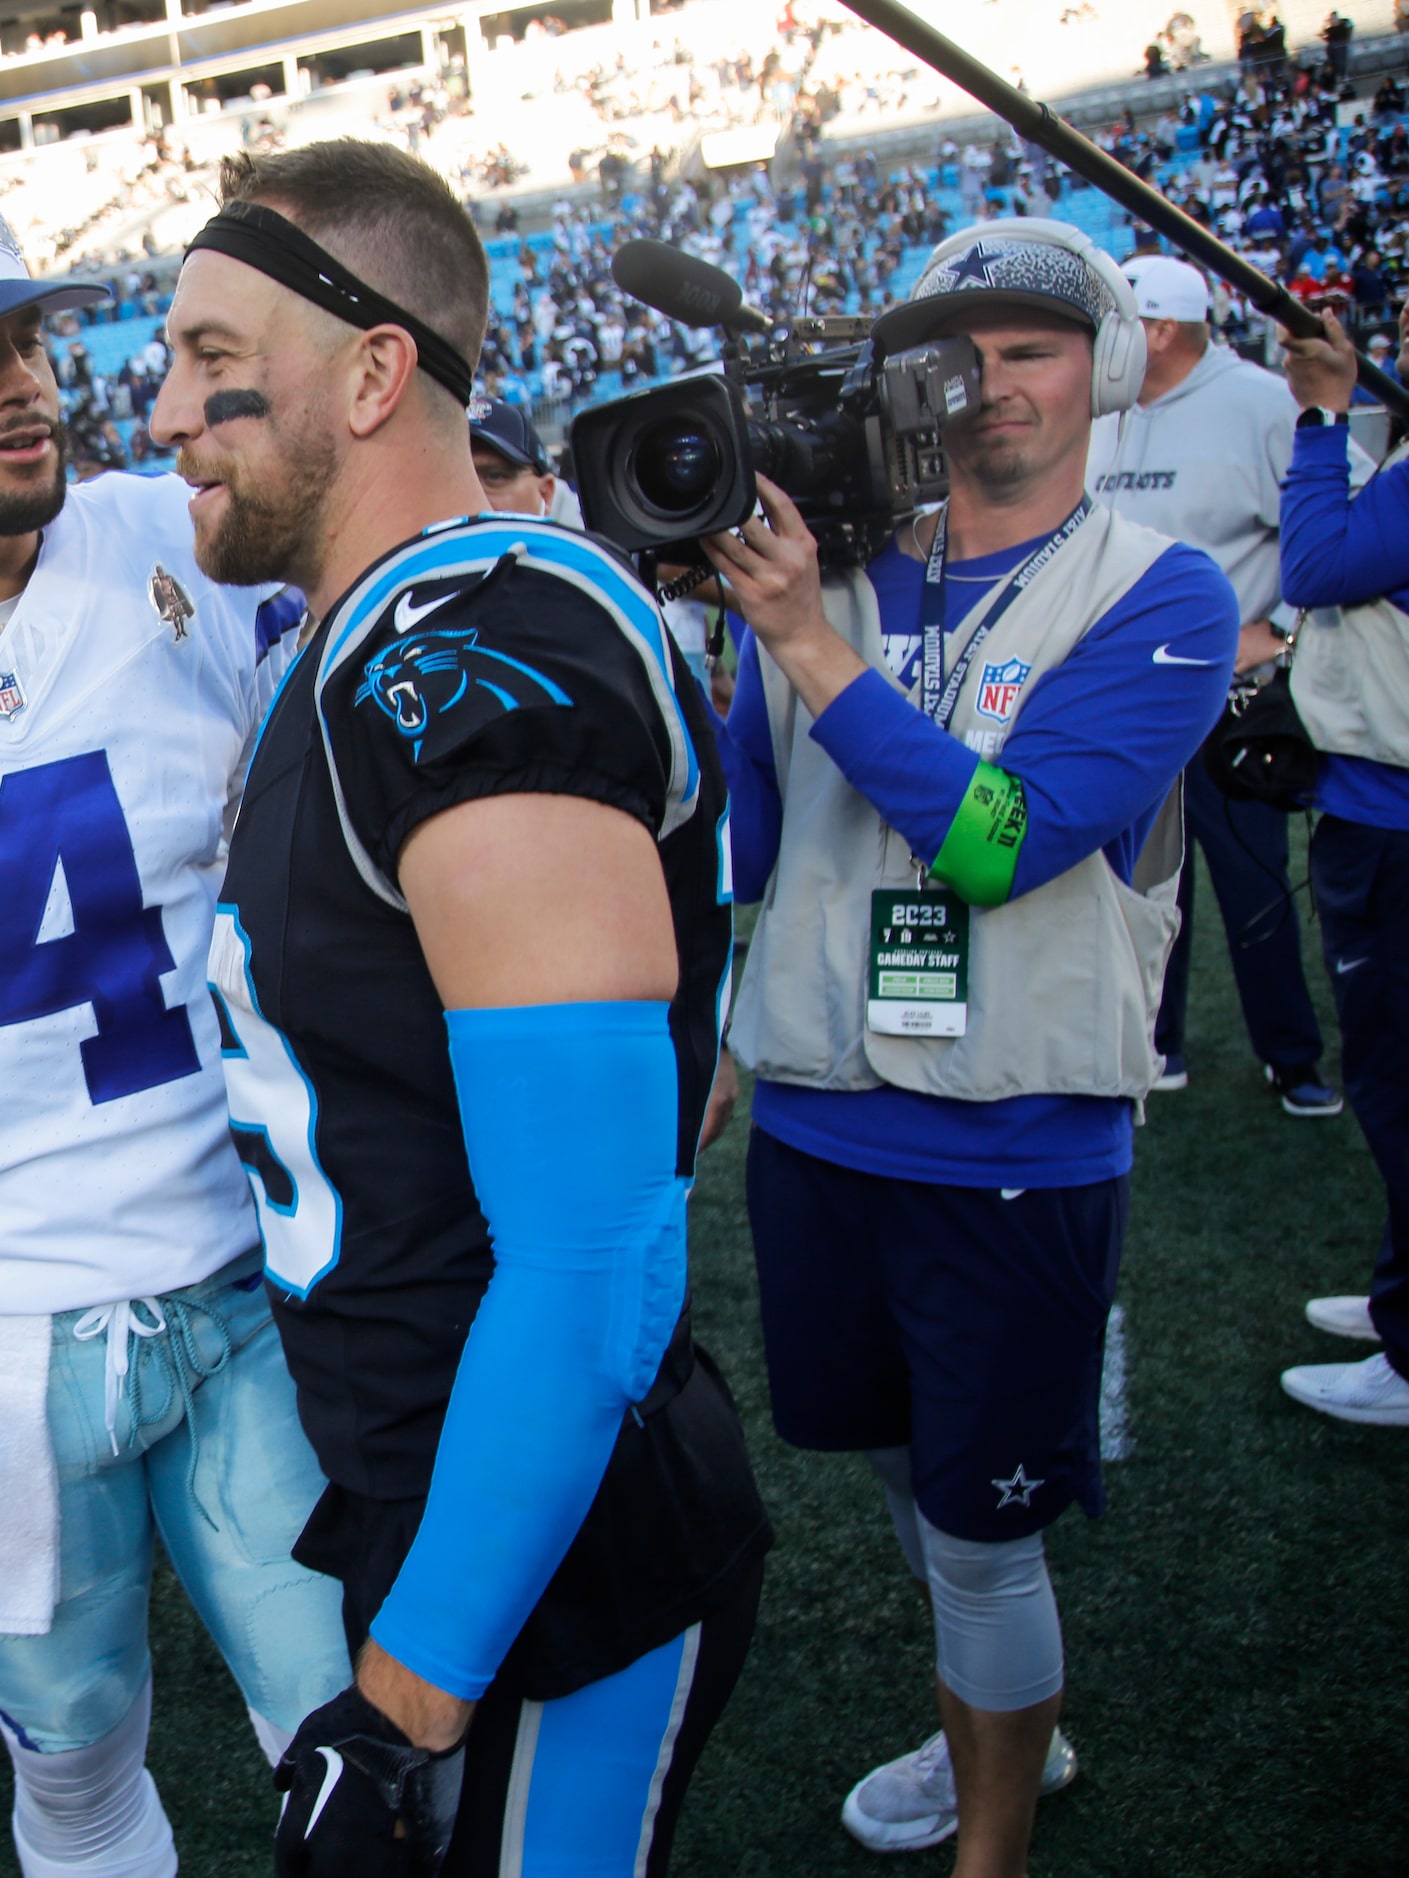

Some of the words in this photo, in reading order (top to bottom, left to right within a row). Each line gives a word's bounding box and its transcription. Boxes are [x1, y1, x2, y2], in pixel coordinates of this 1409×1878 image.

[982, 685, 1022, 716] NF
[877, 952, 926, 967] GAMEDAY
[928, 954, 959, 968] STAFF
